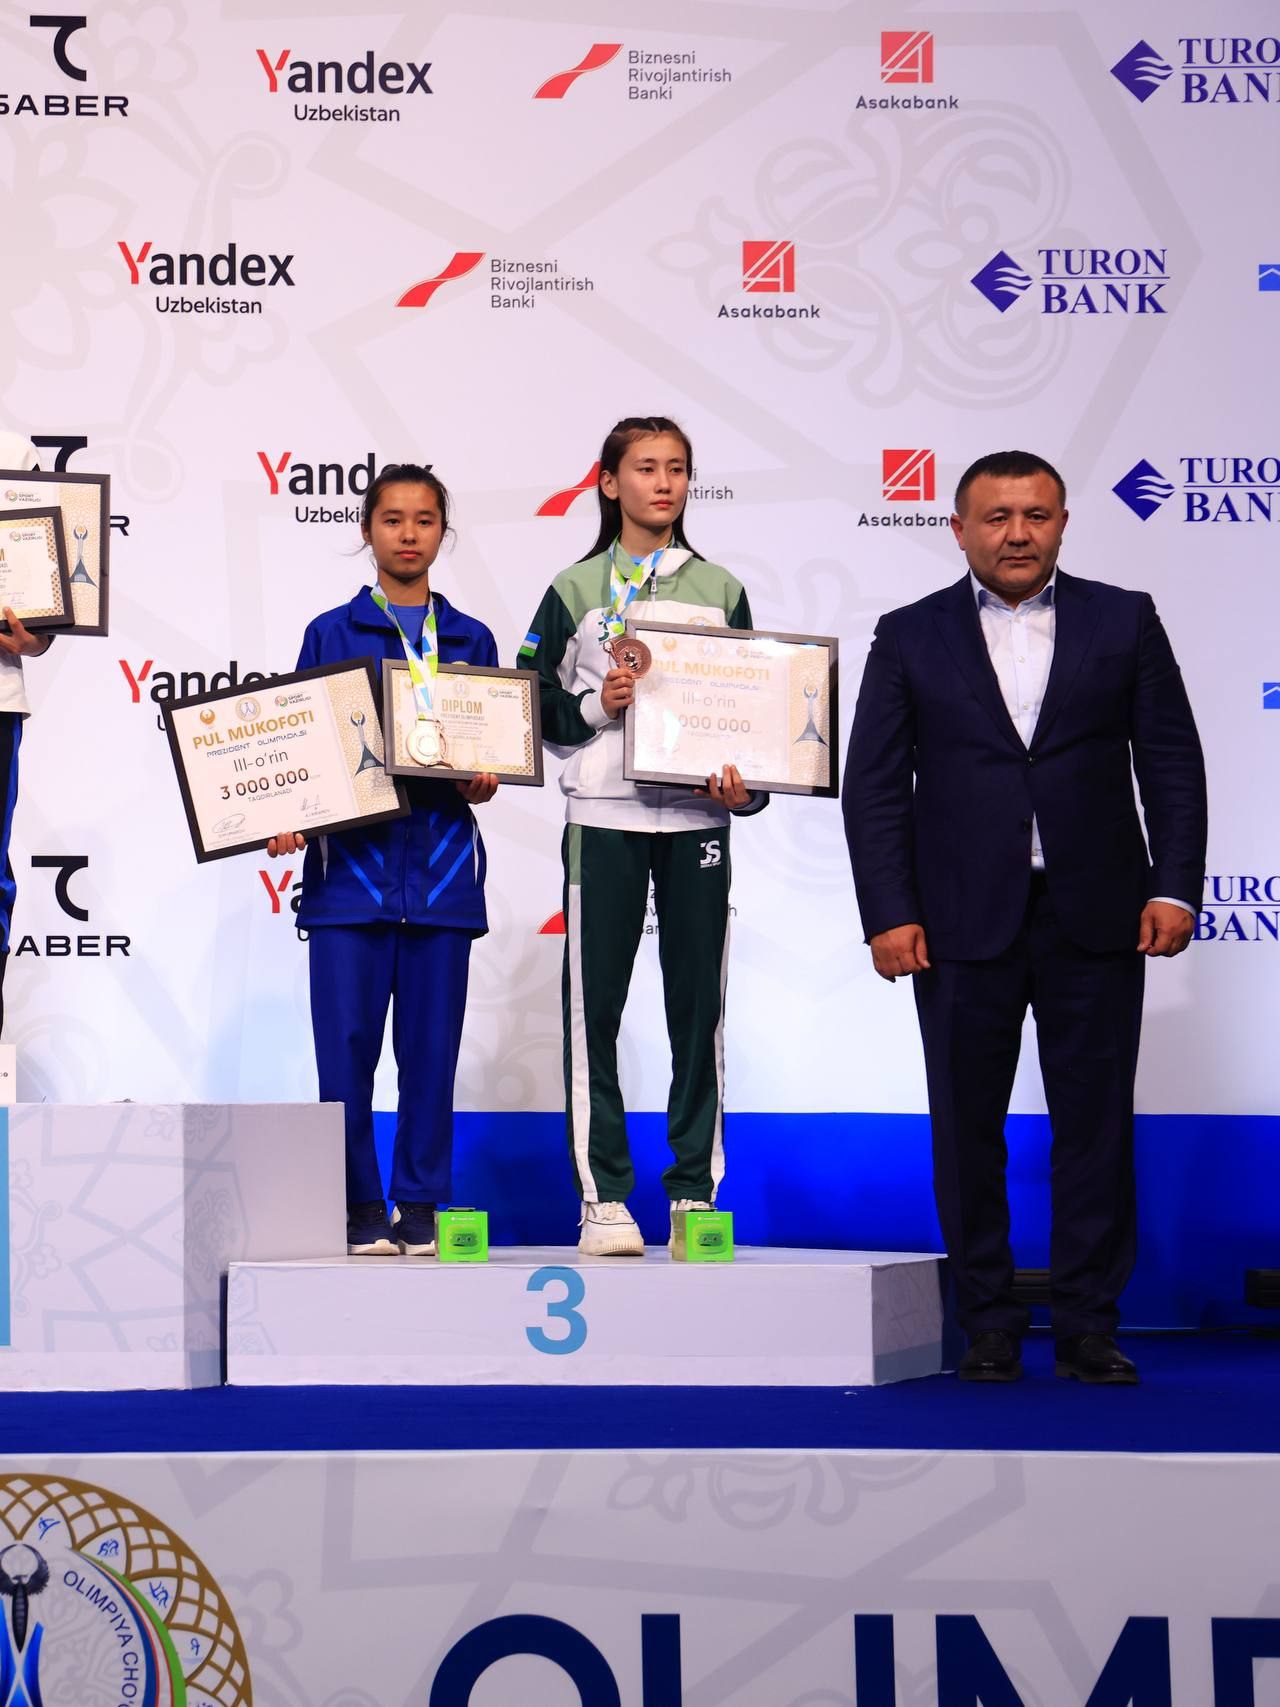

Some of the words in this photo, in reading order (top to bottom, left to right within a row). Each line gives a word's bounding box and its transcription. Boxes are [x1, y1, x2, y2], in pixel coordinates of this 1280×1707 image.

[629, 51, 695, 64] Biznesni
[257, 50, 433, 94] Yandex
[629, 68, 731, 84] Rivojlantirish
[629, 85, 672, 99] Banki
[1182, 73, 1280, 103] BAN
[856, 96, 958, 109] Asakabank
[295, 104, 399, 121] Uzbekistan
[118, 242, 295, 286] Yandex
[491, 259, 557, 272] Biznesni
[1038, 249, 1166, 274] TURON
[491, 277, 593, 293] Rivojlantirish
[156, 297, 261, 313] Uzbekistan
[492, 295, 534, 308] Banki
[1042, 284, 1167, 313] BANK
[718, 305, 819, 318] Asakabank
[257, 452, 433, 495] Yand
[295, 506, 360, 523] Uzbeki
[1184, 493, 1280, 522] BAN
[858, 513, 949, 526] Asakaban
[684, 663, 770, 680] MUKOFOTI
[118, 660, 280, 703] Yand
[441, 698, 483, 715] DIPLOM
[192, 734, 225, 750] PUL
[227, 709, 315, 742] MUKOFOTI
[220, 784, 231, 801] 3
[235, 777, 270, 797] 000
[274, 767, 310, 788] 000
[1204, 876, 1280, 902] URO
[15, 936, 130, 956] ABER
[526, 1267, 587, 1355] 3
[63, 1570, 135, 1649] OLIMPIYA
[118, 1651, 139, 1707] CHO'
